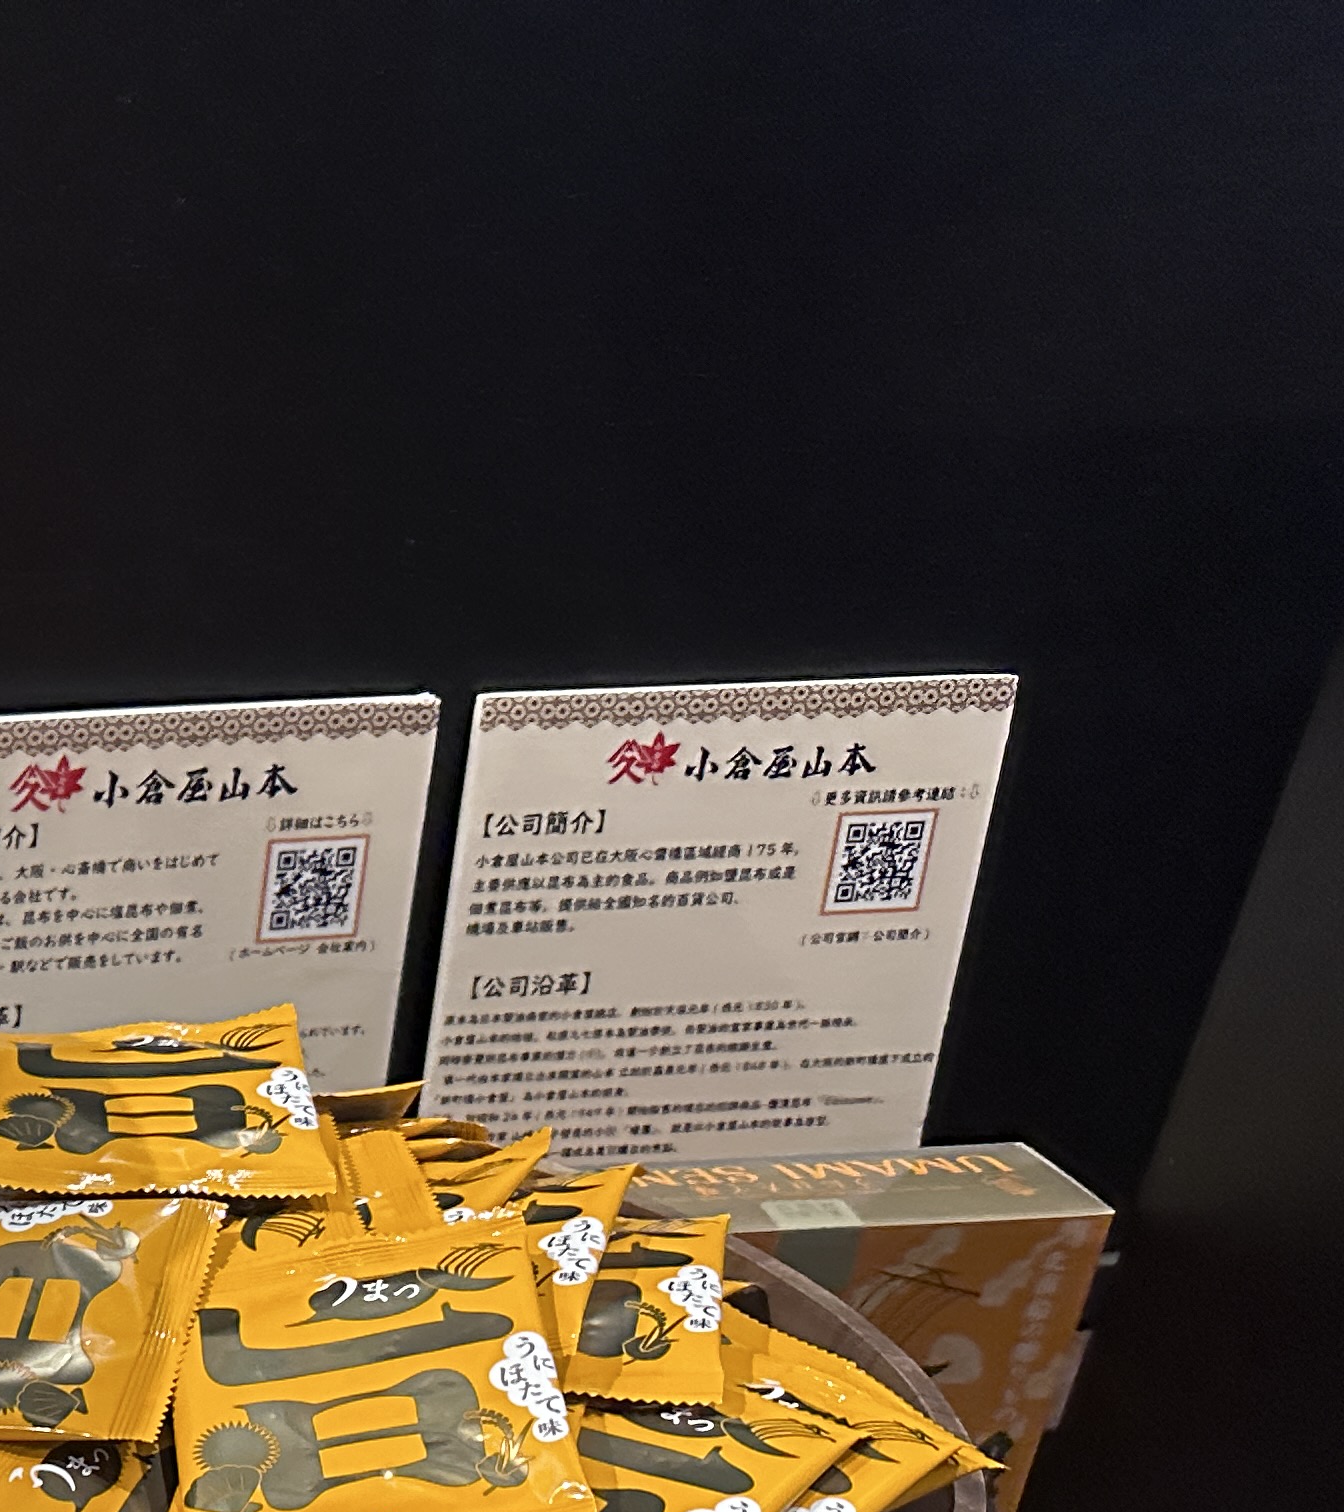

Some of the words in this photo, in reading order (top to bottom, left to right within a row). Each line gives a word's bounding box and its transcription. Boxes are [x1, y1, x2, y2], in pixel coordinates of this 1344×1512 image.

[685, 742, 878, 781] 小倉屋山本
[93, 763, 298, 808] 小倉屋山本
[480, 809, 608, 840] 【公司簡介】
[468, 971, 595, 1001] 【公司沿革】
[770, 1154, 1016, 1180] UMAMI
[574, 1220, 602, 1245] うに
[515, 1337, 556, 1371] うに
[500, 1363, 561, 1414] ほたて
[538, 1419, 563, 1437] 味
